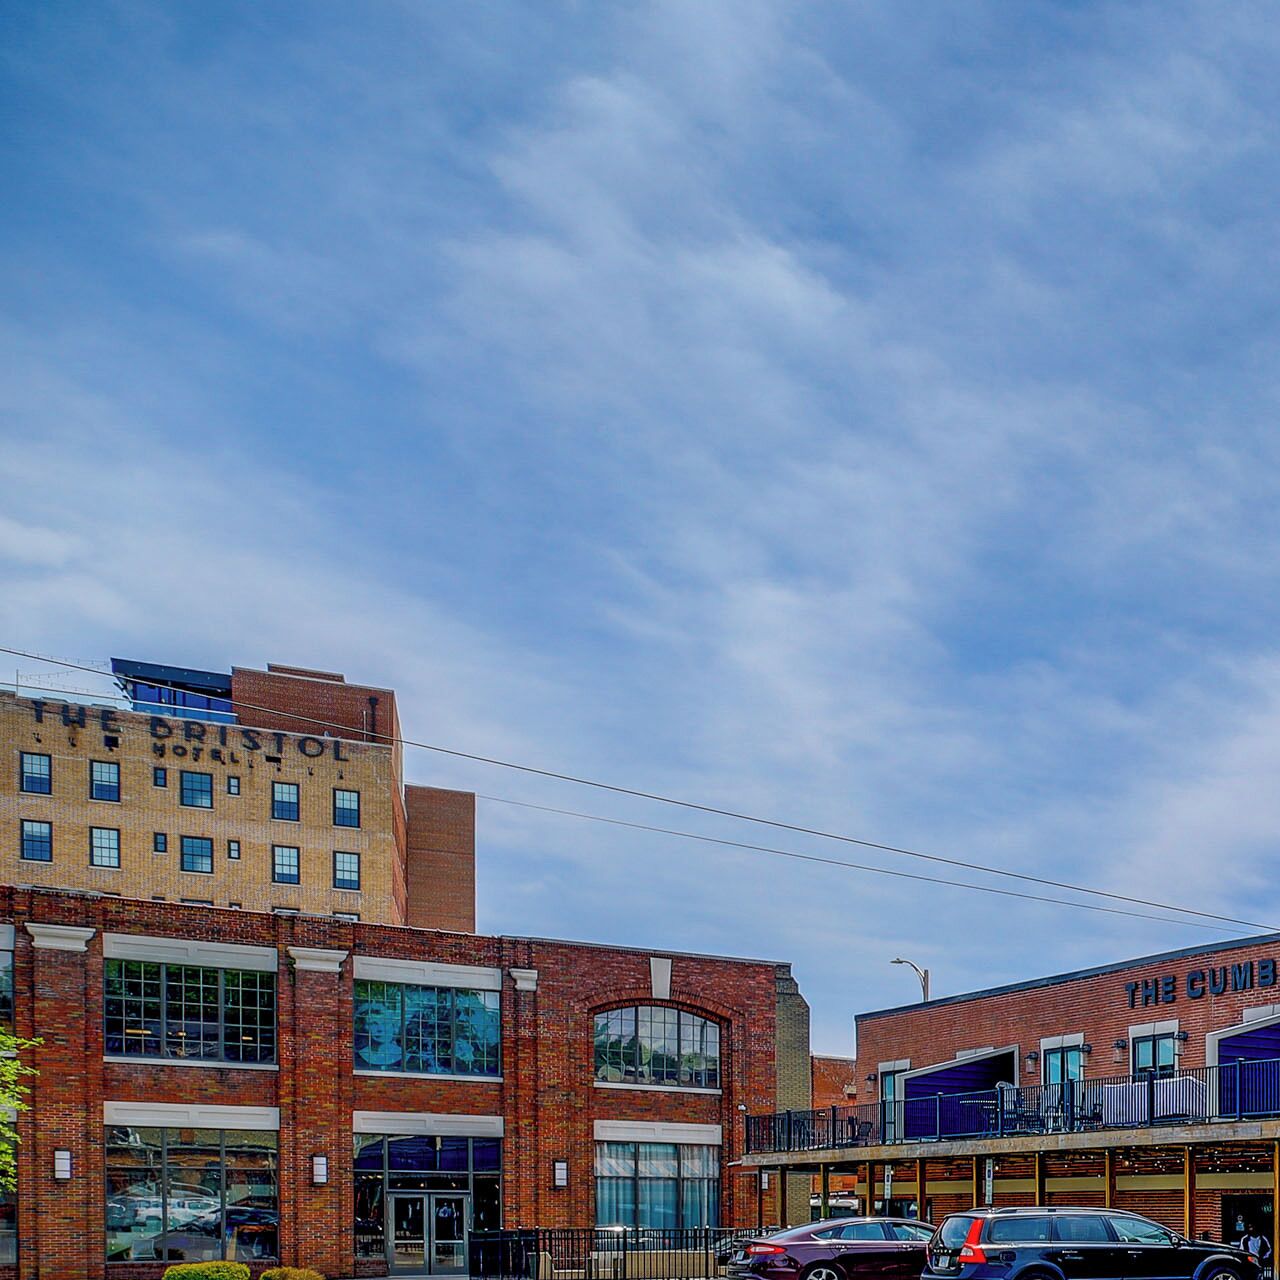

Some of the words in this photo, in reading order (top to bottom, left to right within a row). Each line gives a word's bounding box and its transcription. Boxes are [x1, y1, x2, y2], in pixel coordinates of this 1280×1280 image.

[31, 700, 121, 732] THE
[150, 715, 350, 762] BRISTOL
[153, 742, 240, 765] HOTEL
[1124, 974, 1177, 1009] THE
